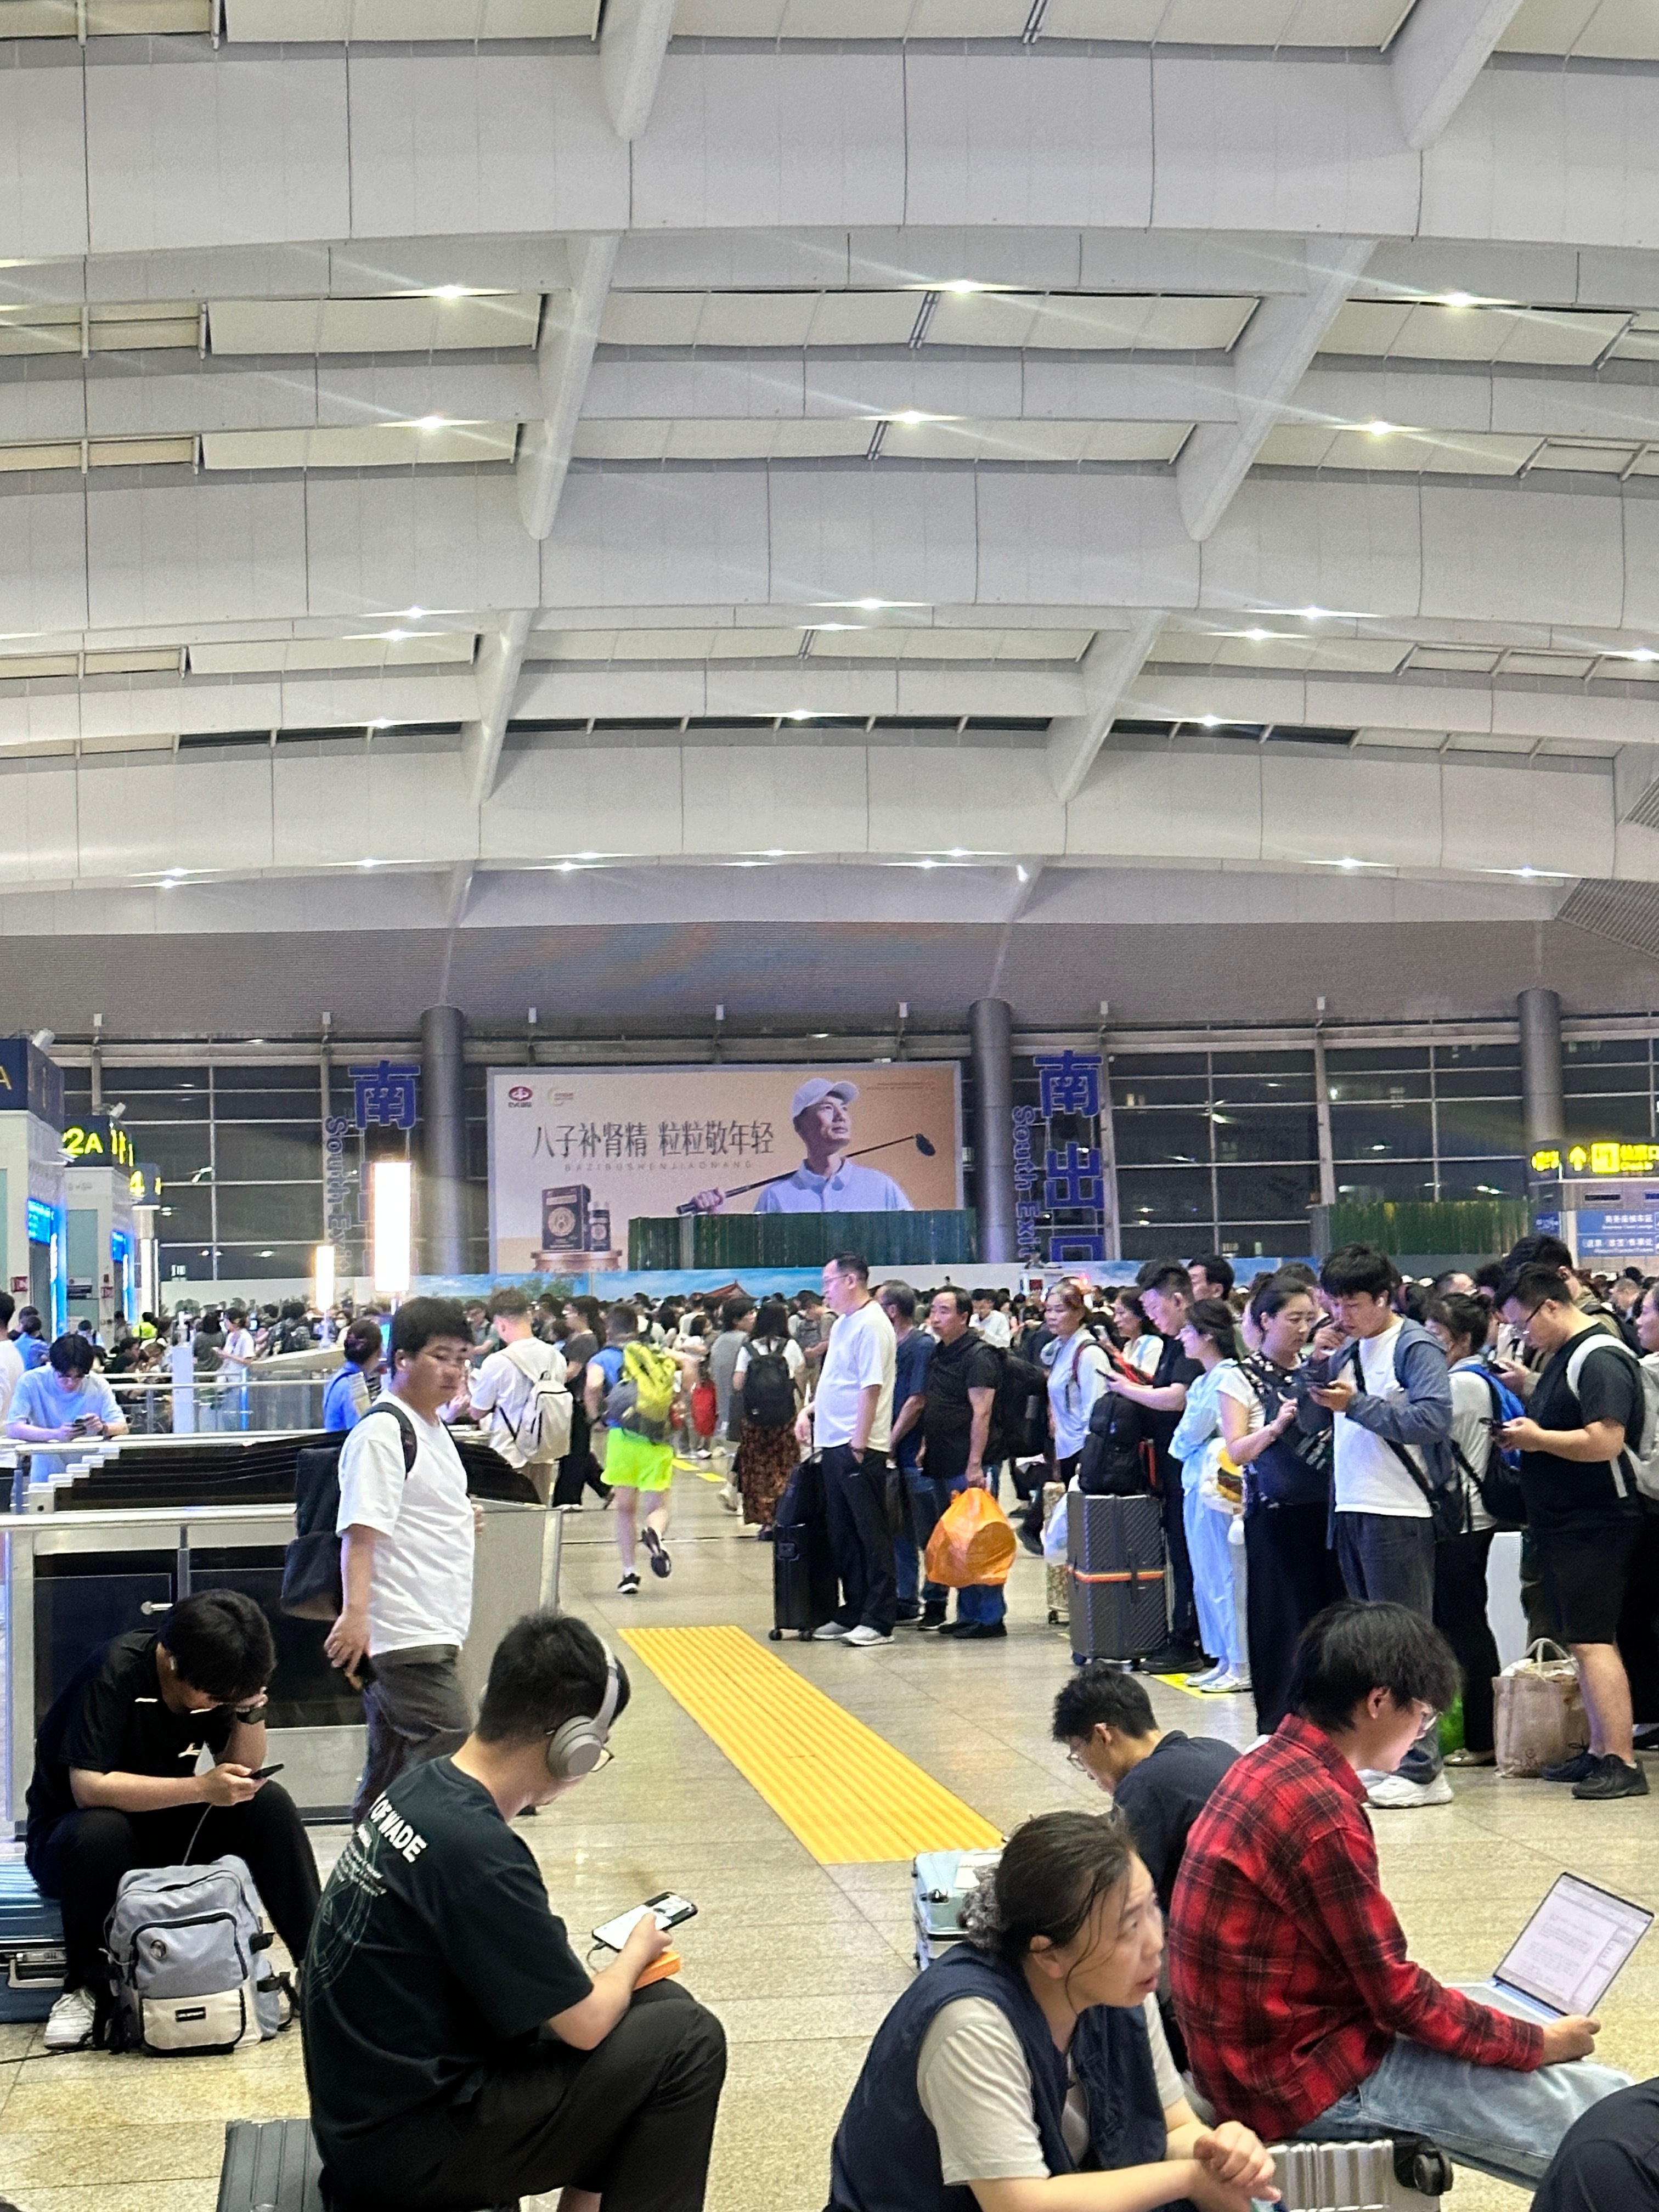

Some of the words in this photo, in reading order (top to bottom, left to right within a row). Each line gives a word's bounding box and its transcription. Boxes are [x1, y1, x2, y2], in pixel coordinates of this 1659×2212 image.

[324, 1116, 351, 1204] South
[532, 1122, 648, 1158] 八子补肾精
[1012, 1105, 1039, 1190] South
[378, 1810, 428, 1863] WADE
